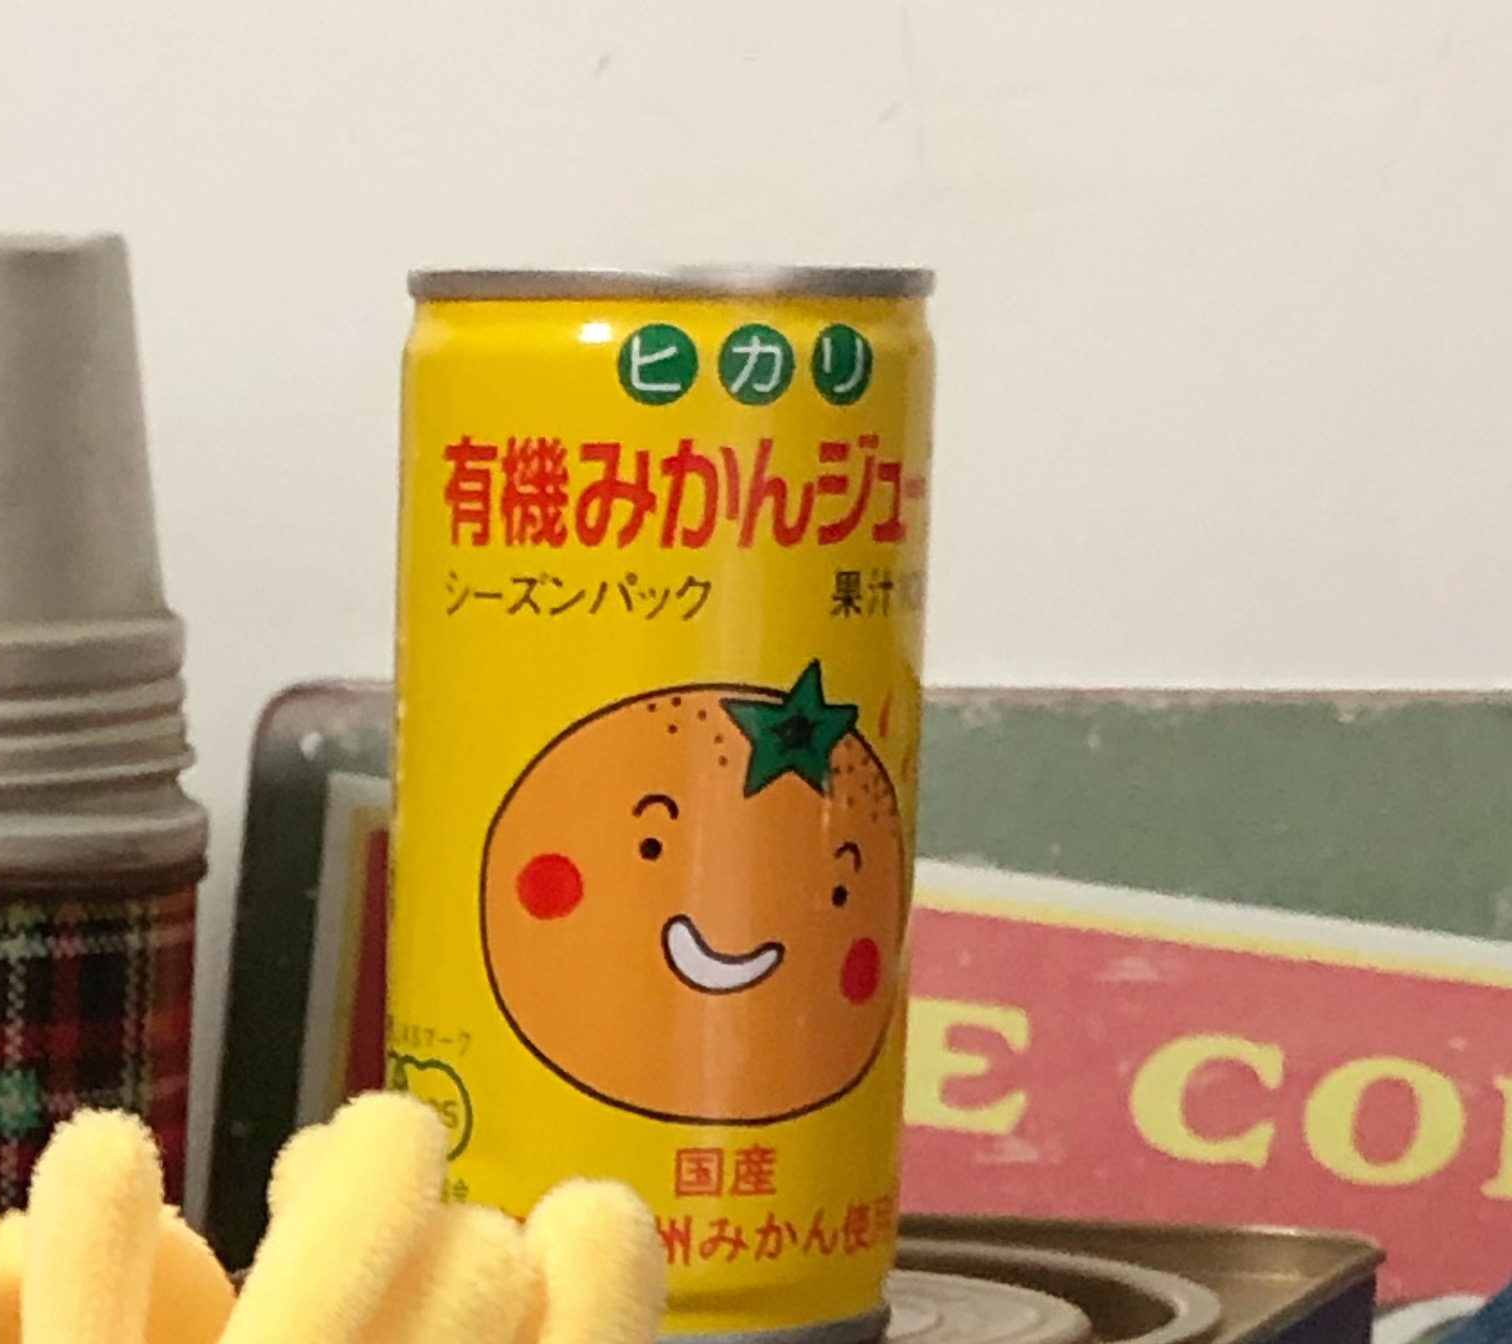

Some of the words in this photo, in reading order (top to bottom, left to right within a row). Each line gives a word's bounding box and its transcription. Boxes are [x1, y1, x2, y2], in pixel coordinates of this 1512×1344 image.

[625, 331, 869, 399] ヒカリ
[444, 571, 713, 619] シーズンパック
[830, 567, 924, 619] 果汁
[1128, 1031, 1512, 1201] CO
[674, 1142, 777, 1197] 国産
